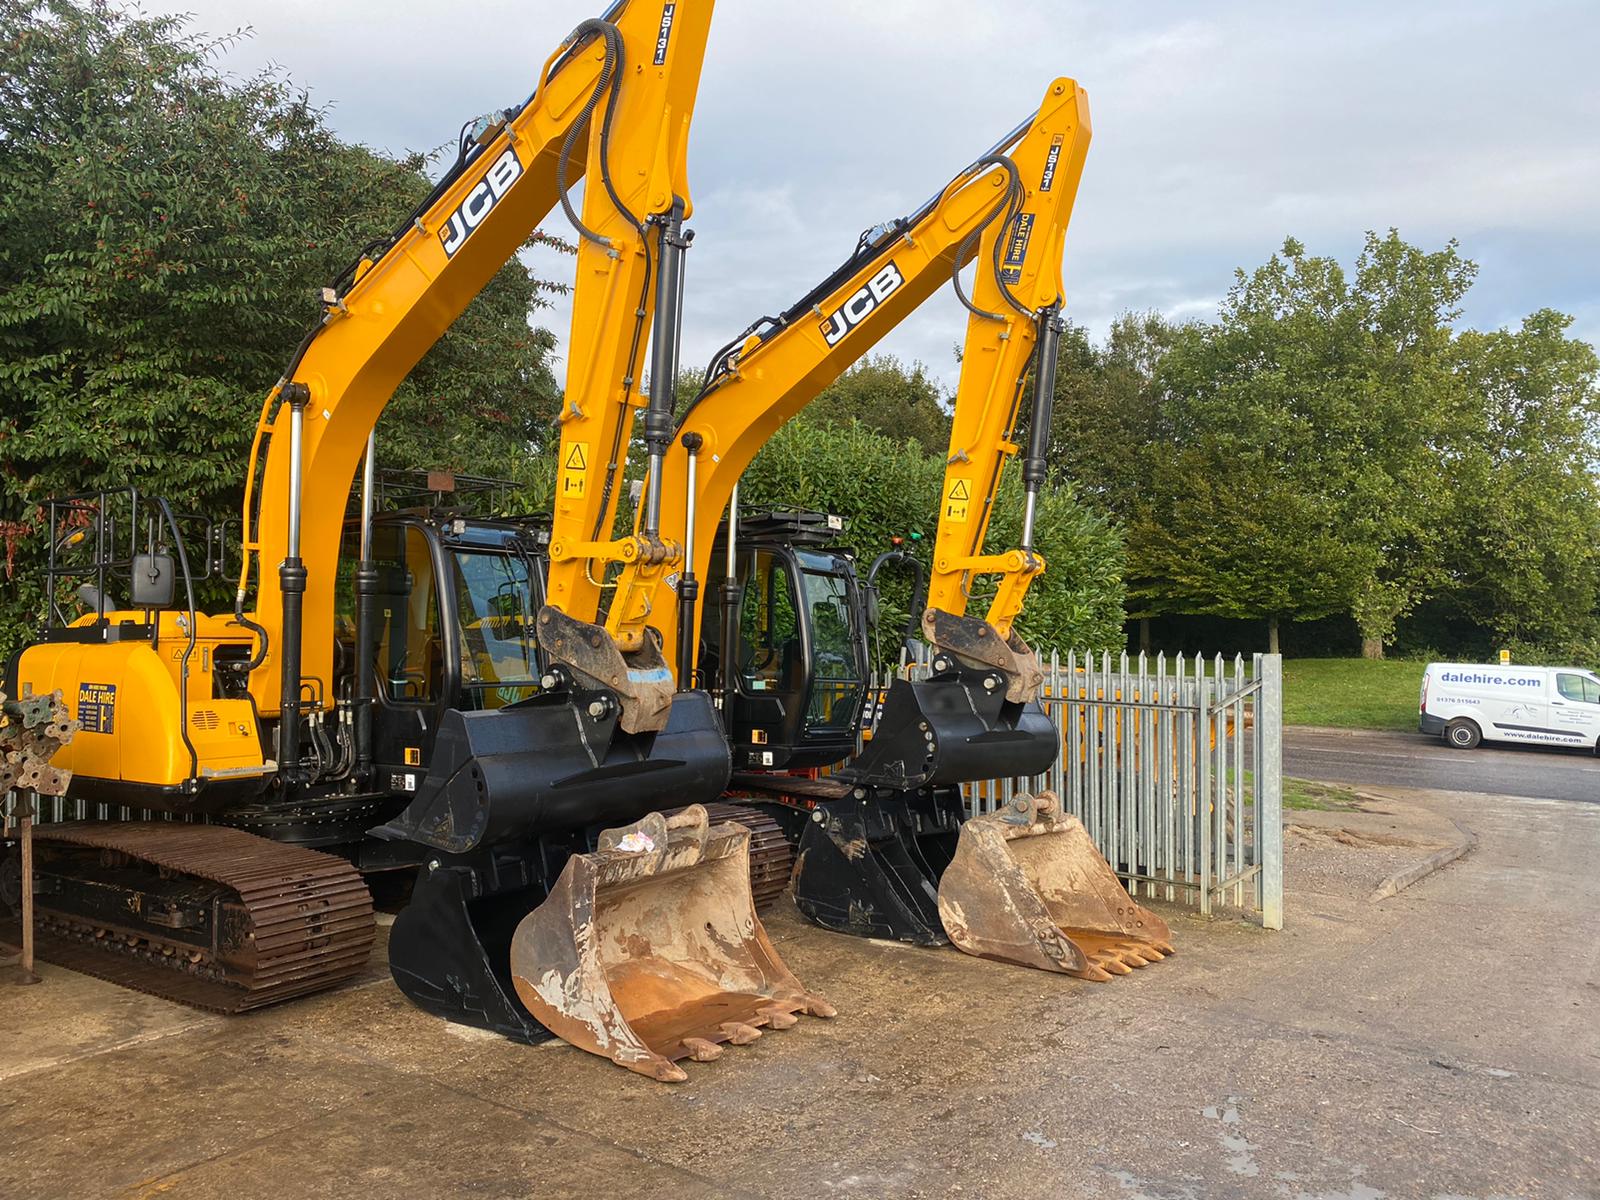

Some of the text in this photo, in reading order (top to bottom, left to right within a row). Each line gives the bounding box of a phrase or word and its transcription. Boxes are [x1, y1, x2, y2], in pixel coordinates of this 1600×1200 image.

[657, 5, 674, 59] JS131
[1043, 146, 1060, 187] JS131
[444, 150, 520, 254] JCB
[1018, 214, 1030, 238] DALE
[1012, 239, 1024, 261] HIRE
[825, 264, 902, 345] JCB
[1441, 672, 1541, 687] dalehire.com
[80, 690, 115, 705] DALE HIRE
[1504, 731, 1582, 744] www.dalehire.com
